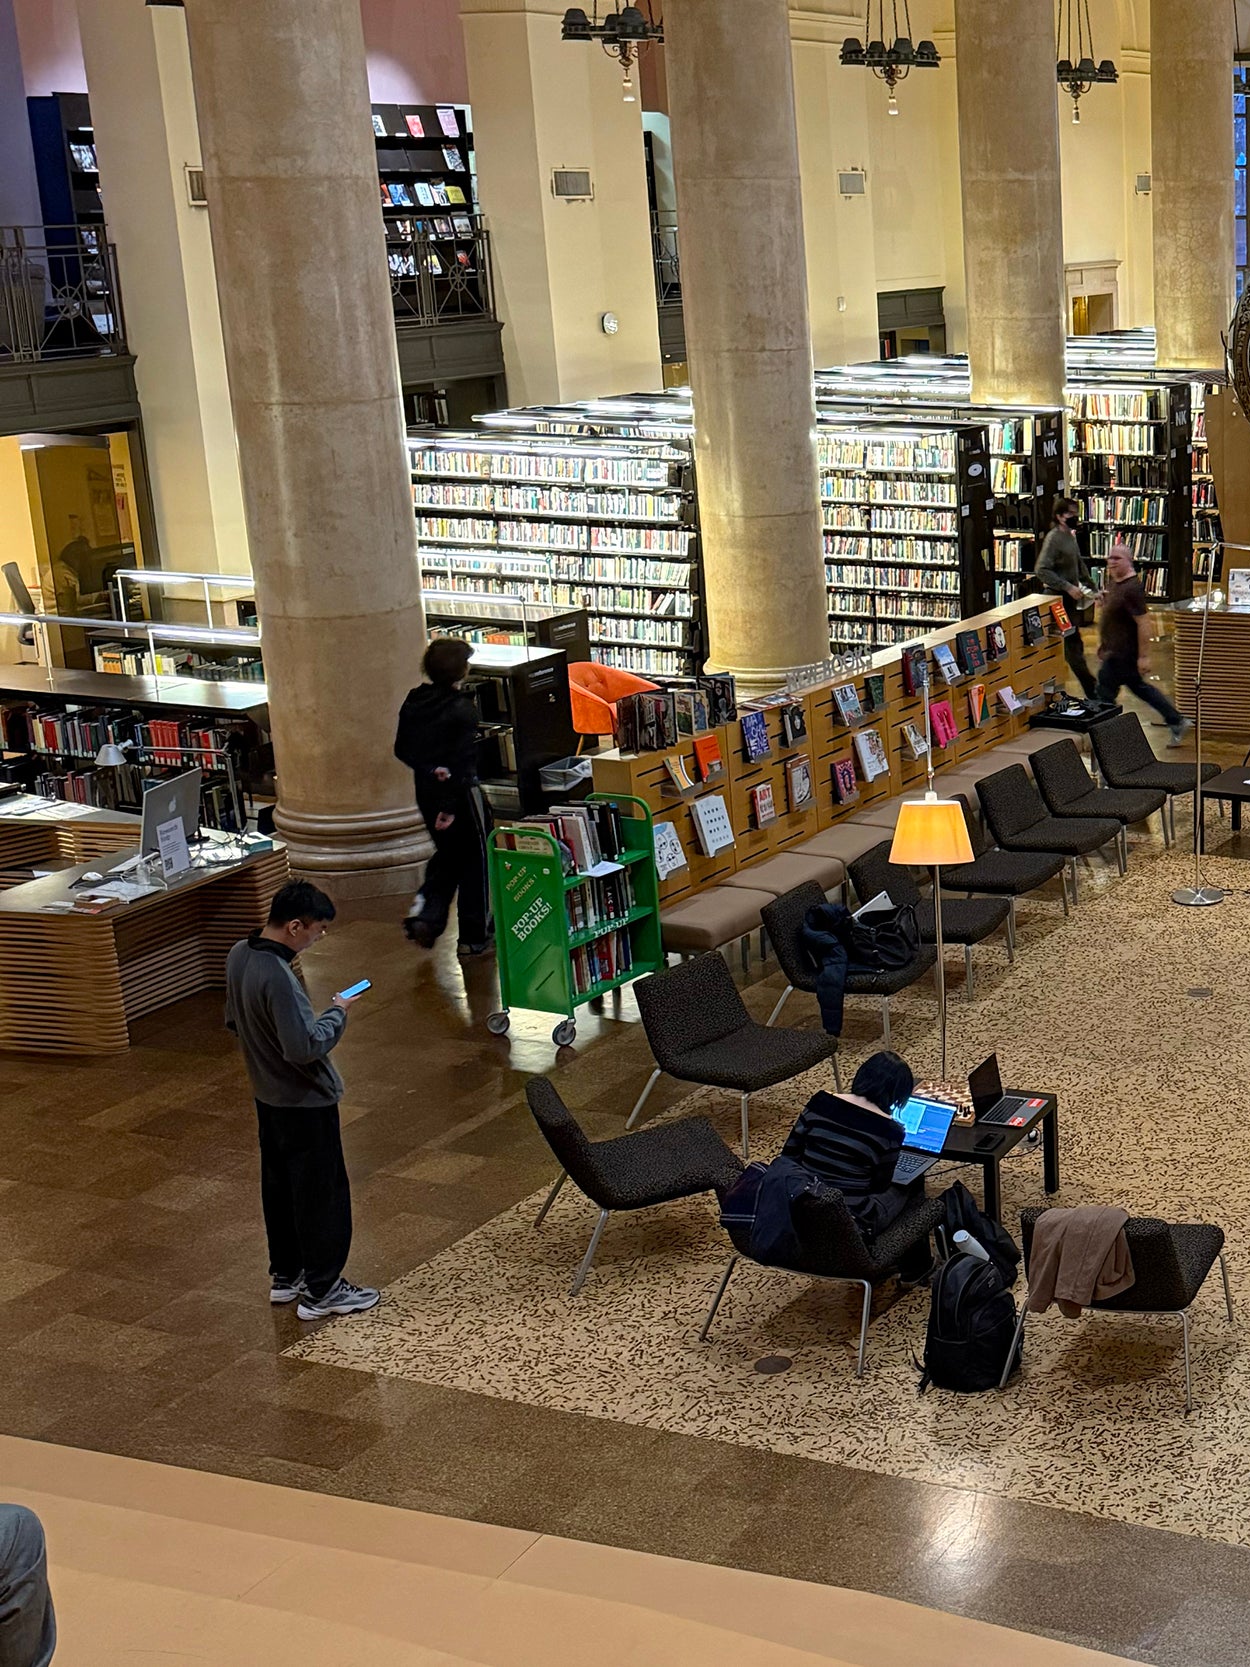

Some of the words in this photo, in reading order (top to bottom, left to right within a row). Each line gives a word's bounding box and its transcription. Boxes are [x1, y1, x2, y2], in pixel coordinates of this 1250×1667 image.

[1043, 440, 1058, 458] NK
[505, 866, 527, 891] POP-UP
[511, 897, 544, 935] POP-UP
[517, 902, 553, 942] BOOKS!
